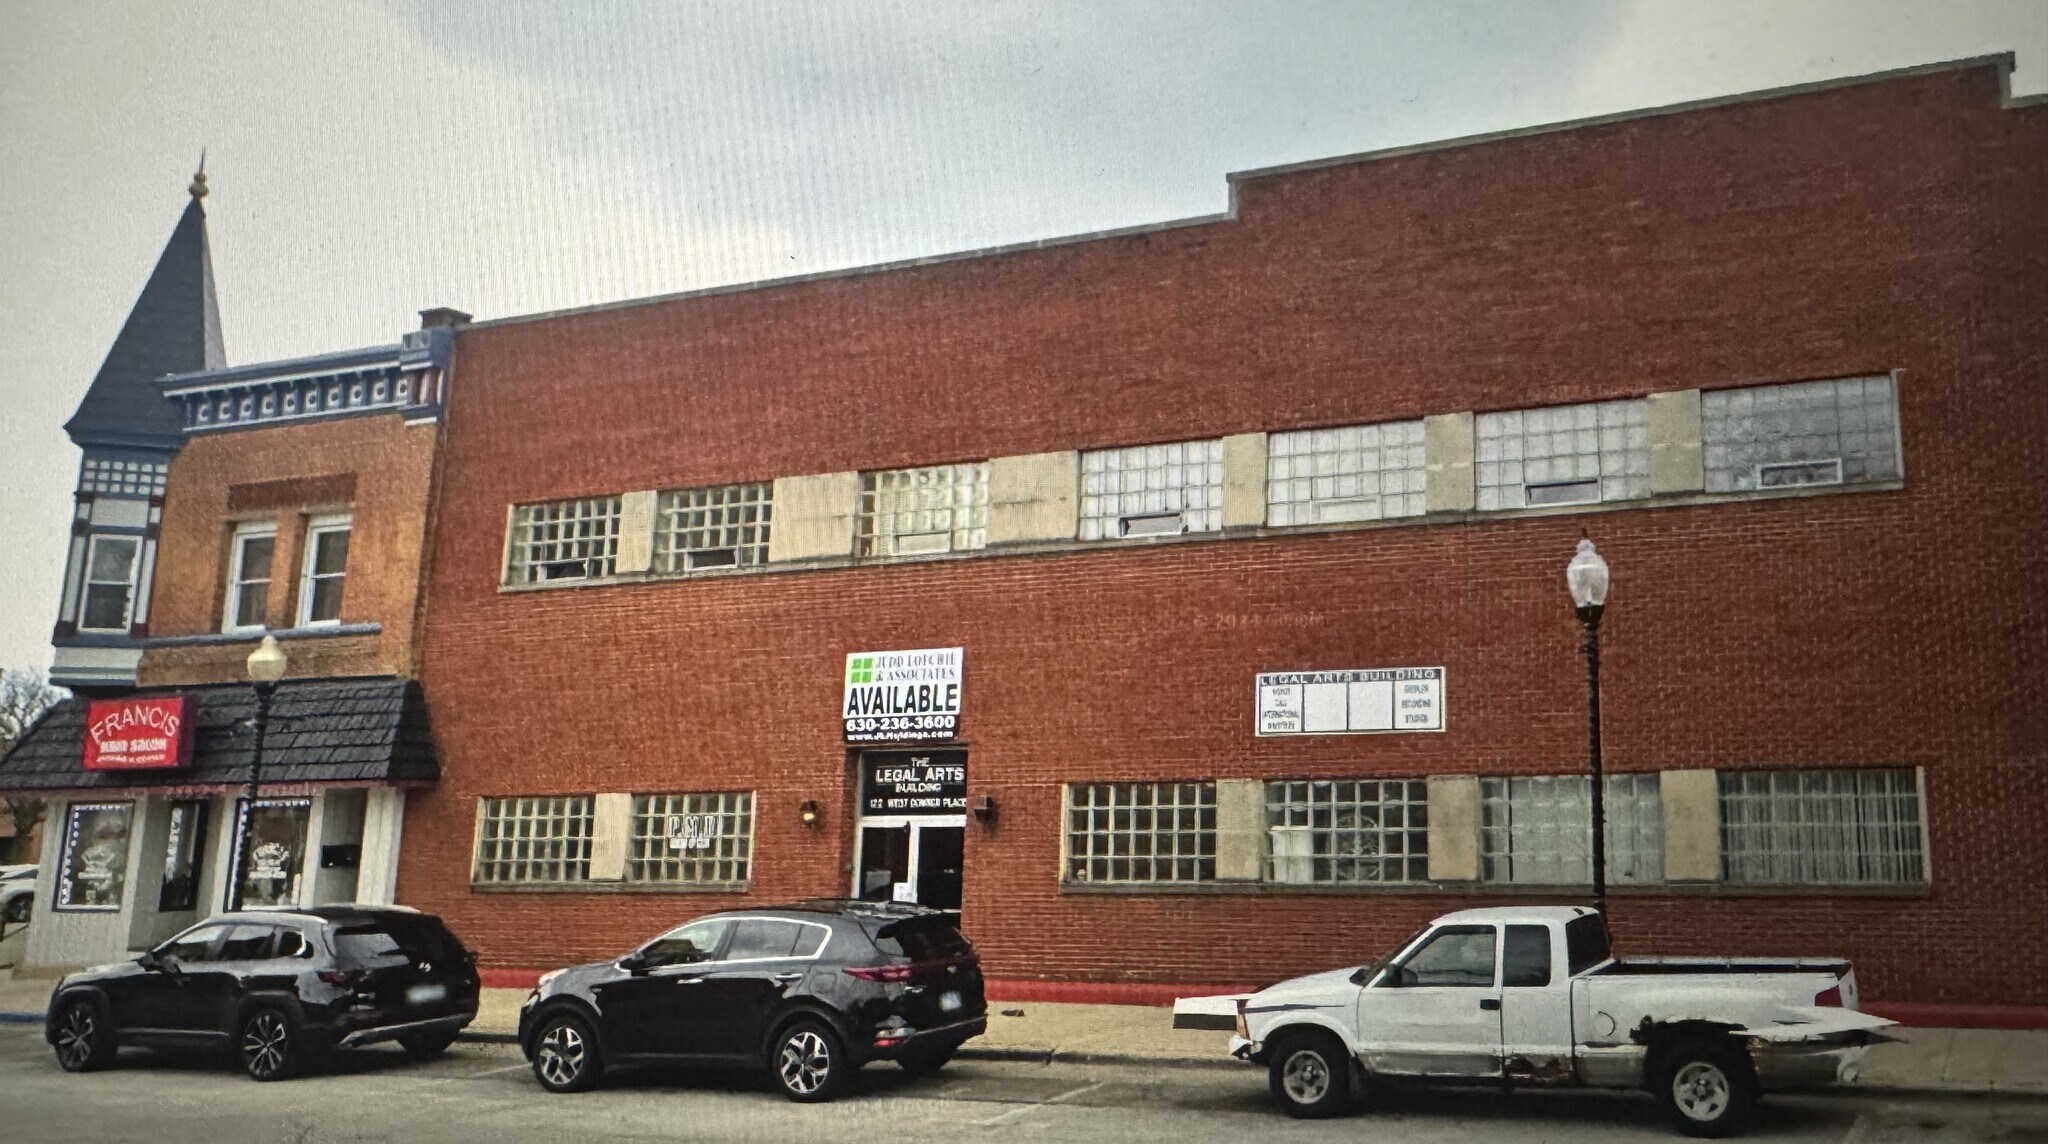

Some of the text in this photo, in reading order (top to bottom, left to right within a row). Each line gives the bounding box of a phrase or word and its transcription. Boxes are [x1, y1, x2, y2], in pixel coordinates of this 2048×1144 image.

[1261, 674, 1308, 685] LEGAL
[847, 684, 957, 715] AVAILABLE
[90, 704, 180, 746] FRANCIS
[846, 716, 955, 731] 630-236-3600
[911, 757, 929, 767] THE
[876, 767, 965, 783] LEGAL ARTS
